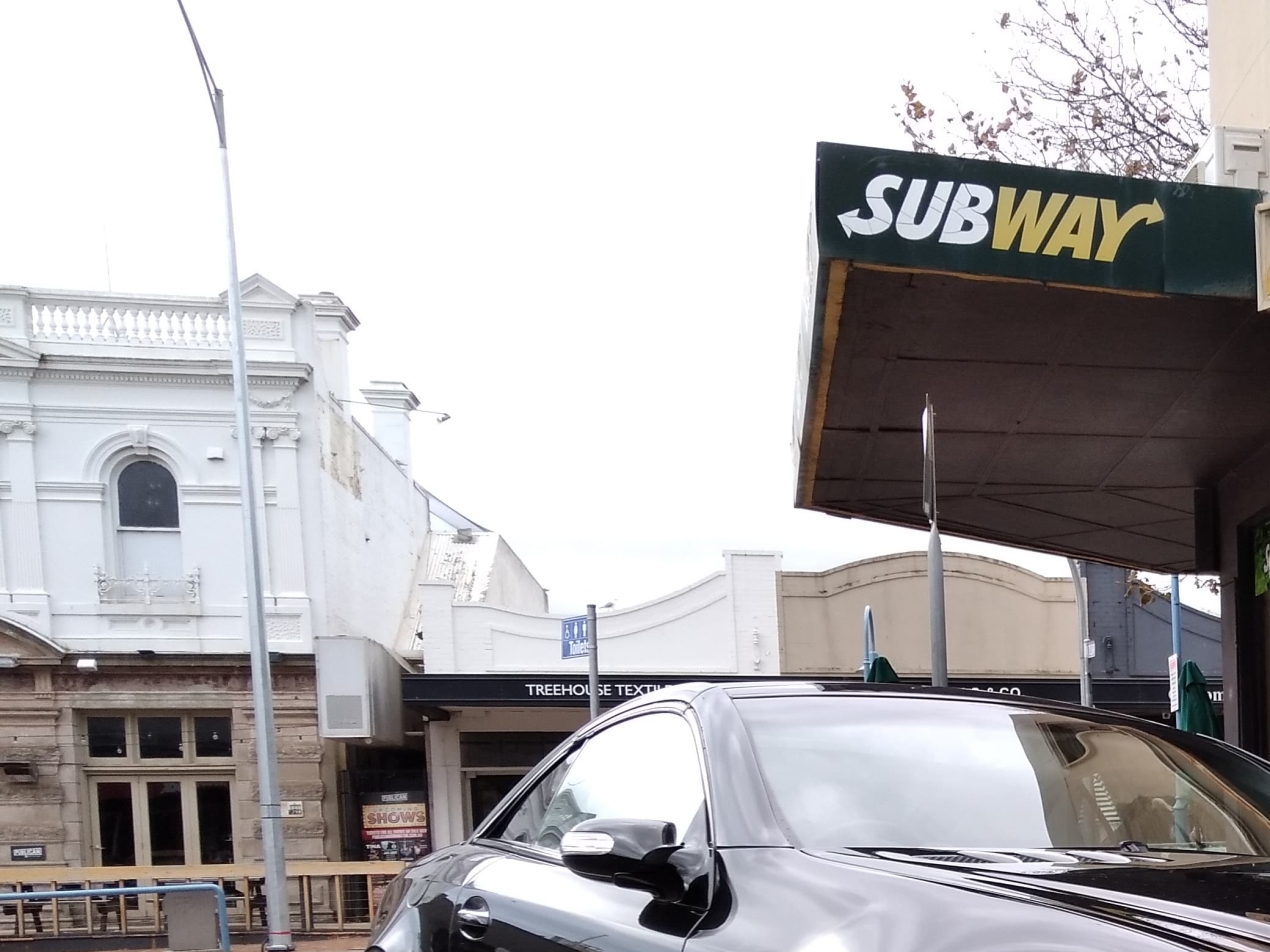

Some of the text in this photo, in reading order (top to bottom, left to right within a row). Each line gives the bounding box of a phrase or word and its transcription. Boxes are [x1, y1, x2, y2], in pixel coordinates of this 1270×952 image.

[837, 174, 1164, 262] SUBWAY
[525, 684, 675, 696] TREEHOUSE TEXTI
[367, 811, 426, 824] SHOWS
